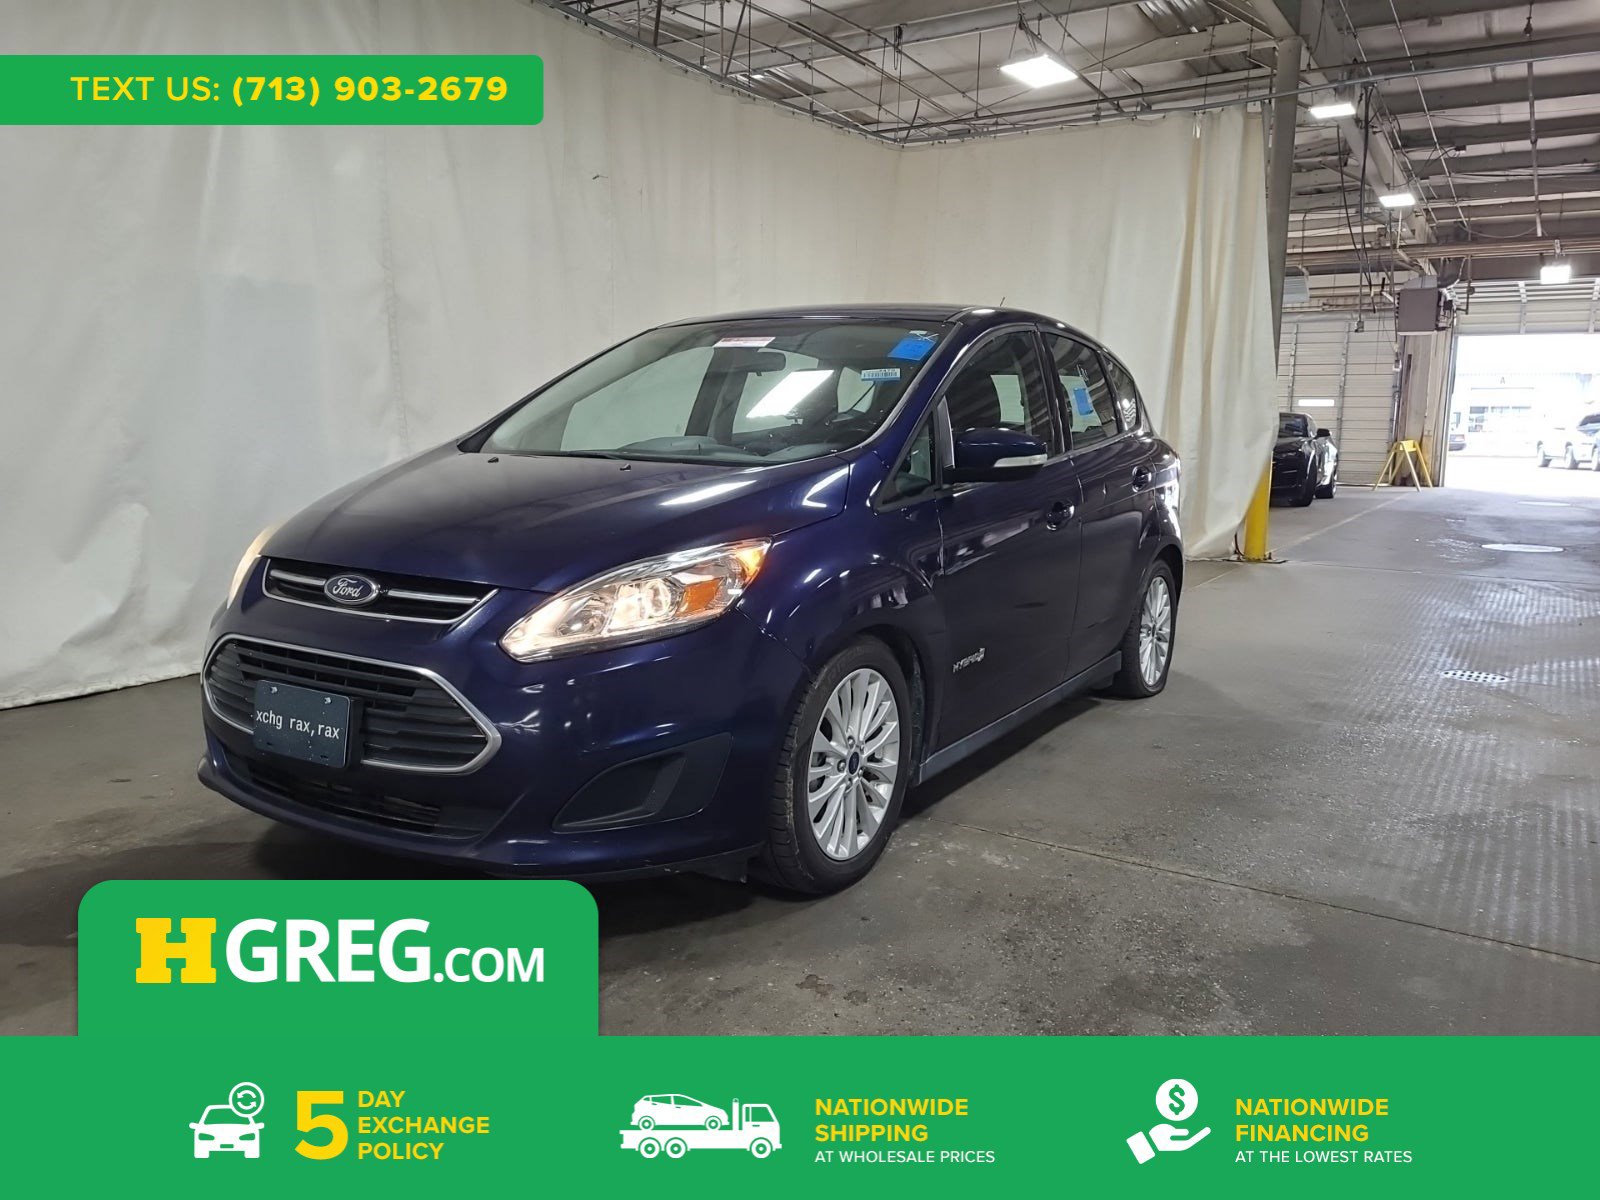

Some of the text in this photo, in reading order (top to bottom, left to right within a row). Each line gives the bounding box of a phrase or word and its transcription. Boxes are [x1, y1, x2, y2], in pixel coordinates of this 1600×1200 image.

[332, 577, 364, 598] Ford
[256, 710, 340, 740] xchg rax,rax
